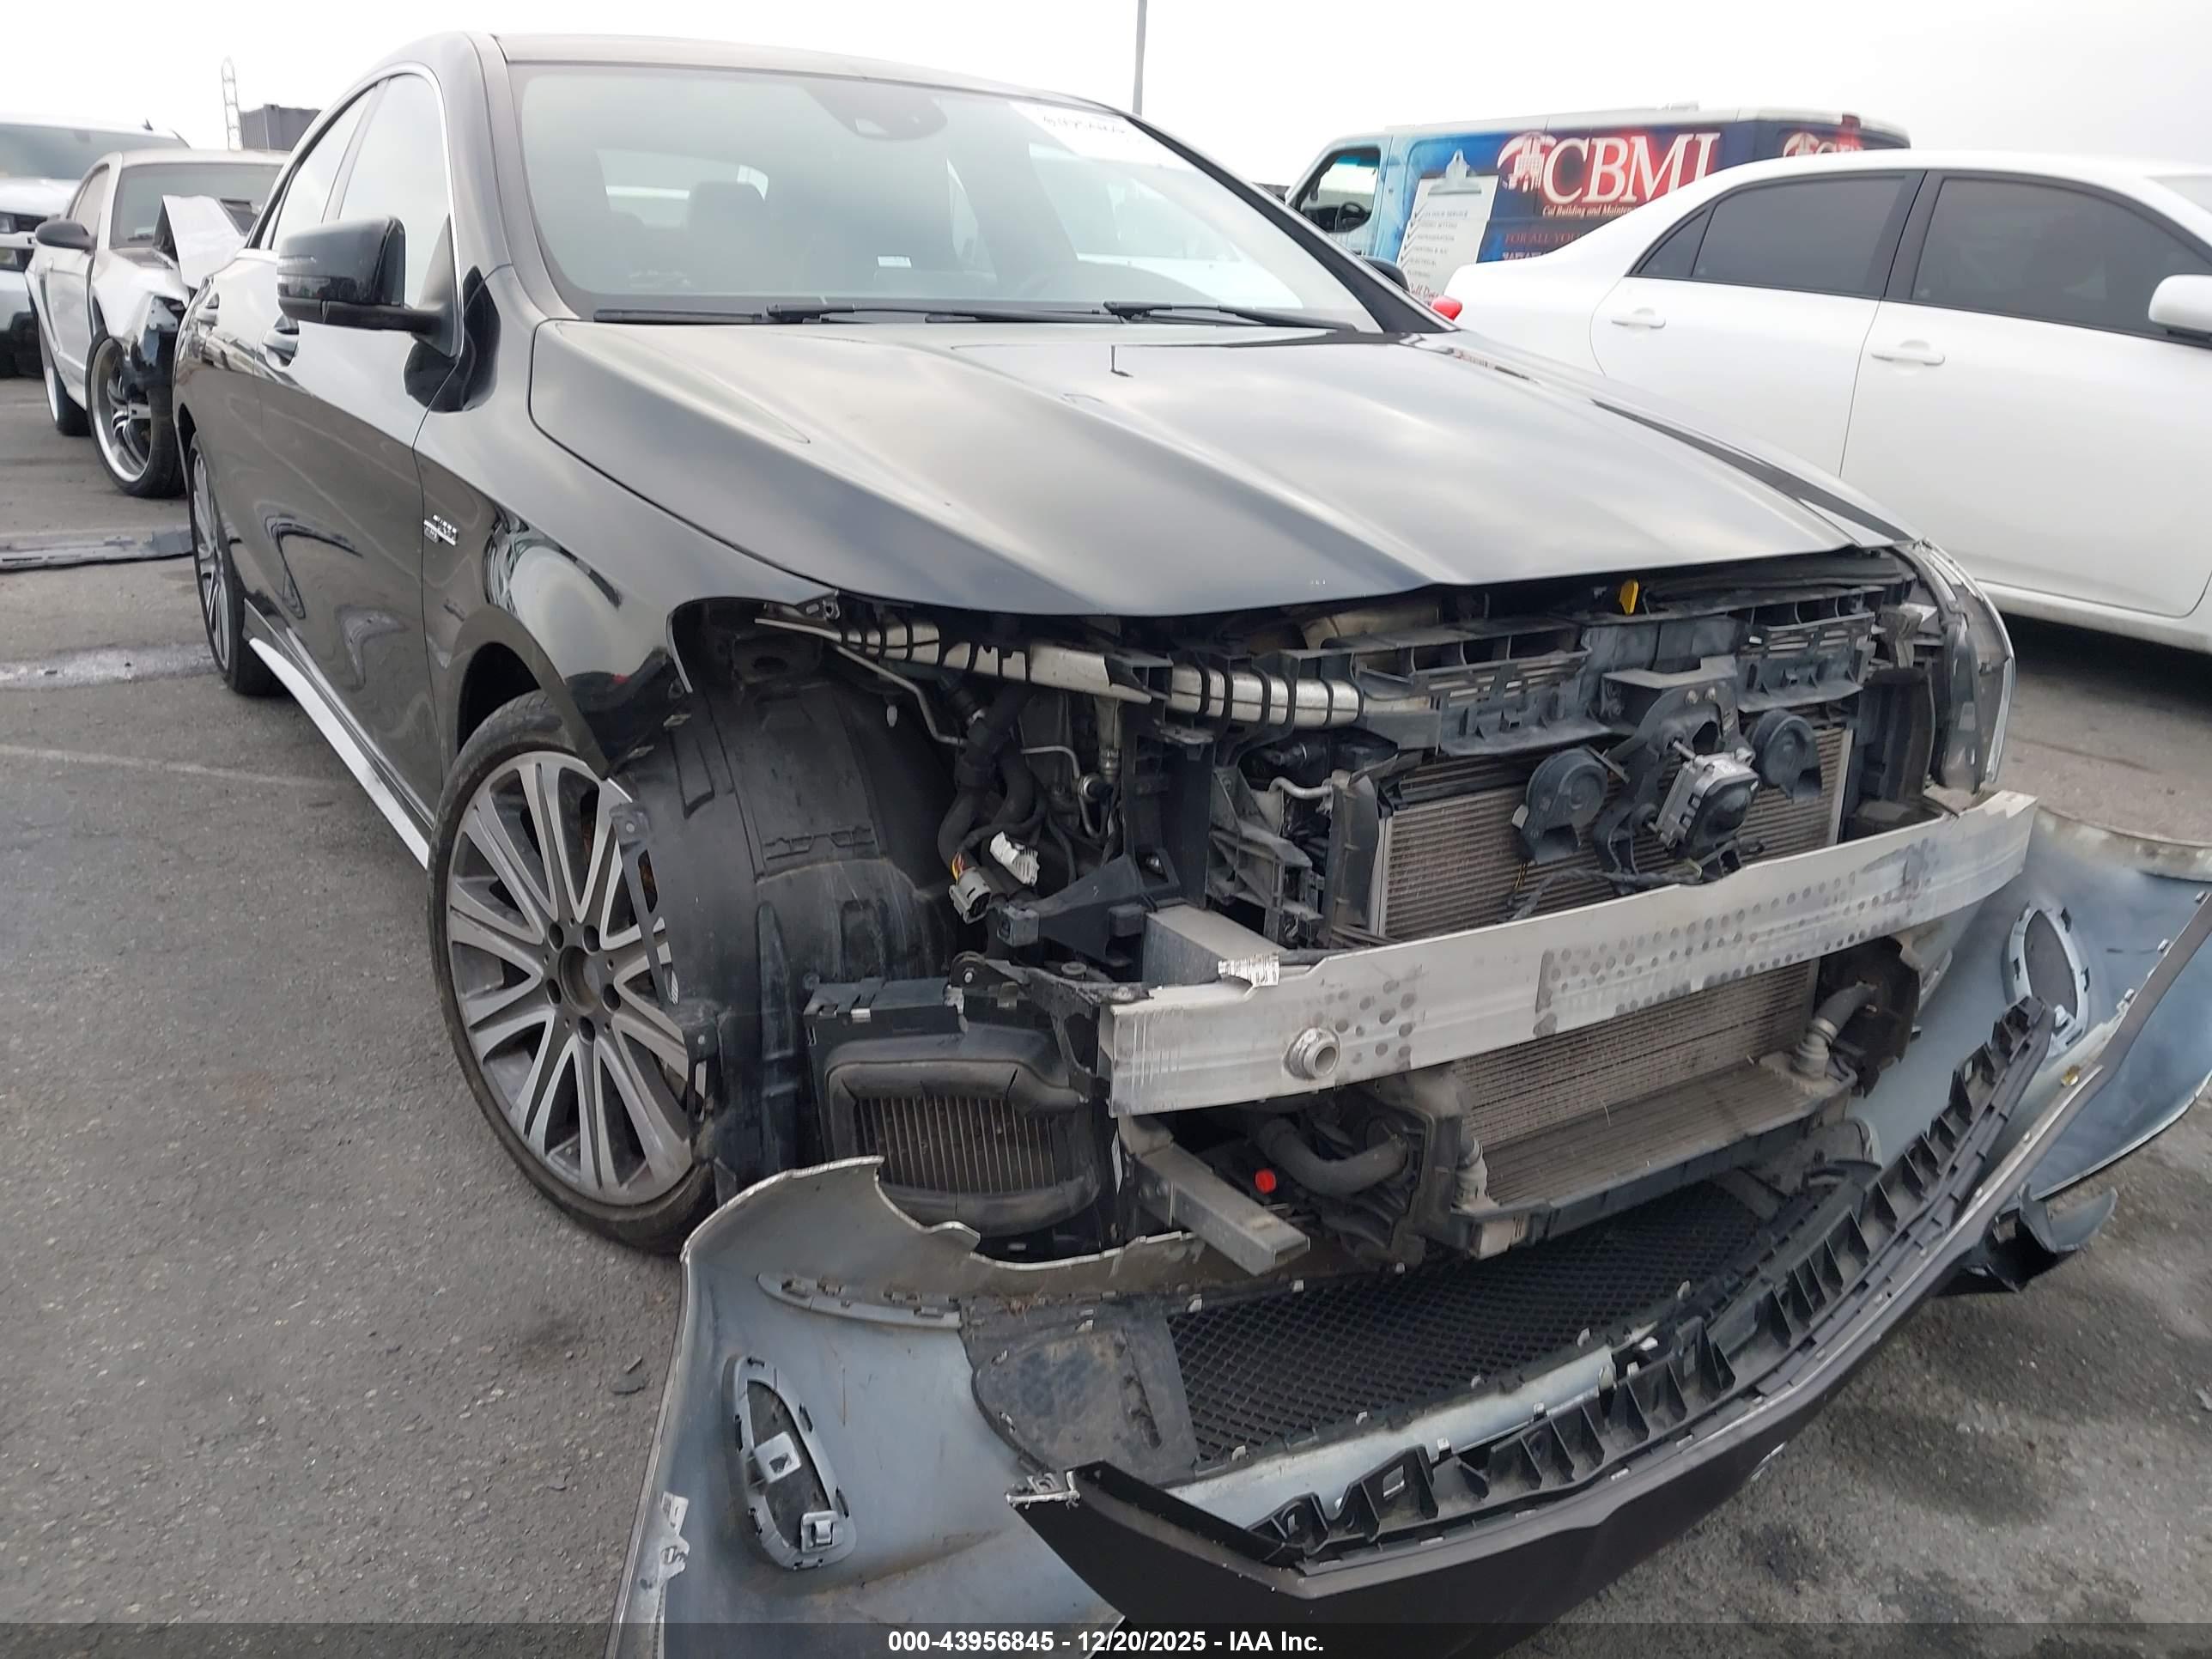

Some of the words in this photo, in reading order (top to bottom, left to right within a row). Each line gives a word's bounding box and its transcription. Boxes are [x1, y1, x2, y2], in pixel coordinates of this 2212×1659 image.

[1542, 133, 1721, 204] CBMI
[1556, 205, 1585, 218] Building
[1587, 204, 1601, 216] and
[1505, 233, 1526, 244] FOR
[1531, 233, 1548, 243] ALL
